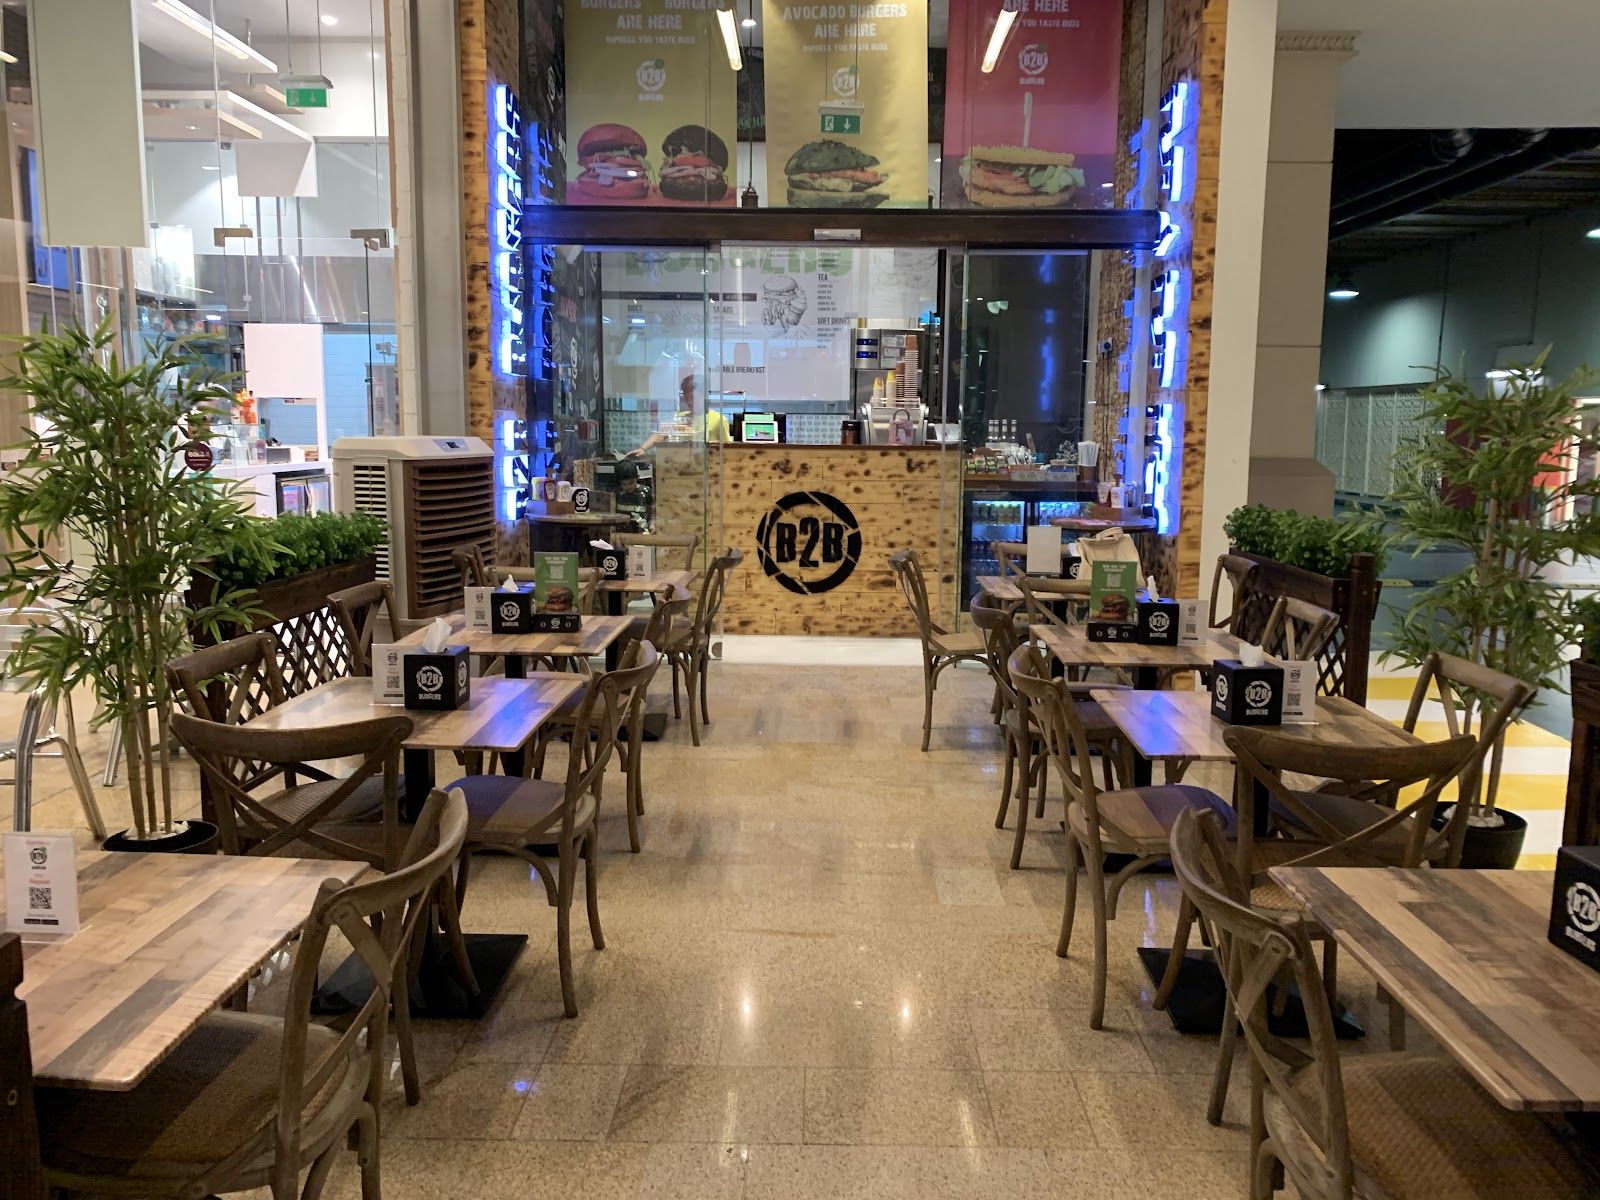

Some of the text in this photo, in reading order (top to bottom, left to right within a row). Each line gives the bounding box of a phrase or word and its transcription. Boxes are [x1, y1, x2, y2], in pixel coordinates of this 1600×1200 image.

[783, 4, 908, 20] AVOCADO BURGERS
[1035, 0, 1069, 12] HERE
[616, 14, 683, 30] ARE HERE
[814, 23, 877, 37] ARE HERE
[818, 273, 828, 281] TEA
[713, 306, 733, 314] SAADS
[776, 516, 845, 568] B2B
